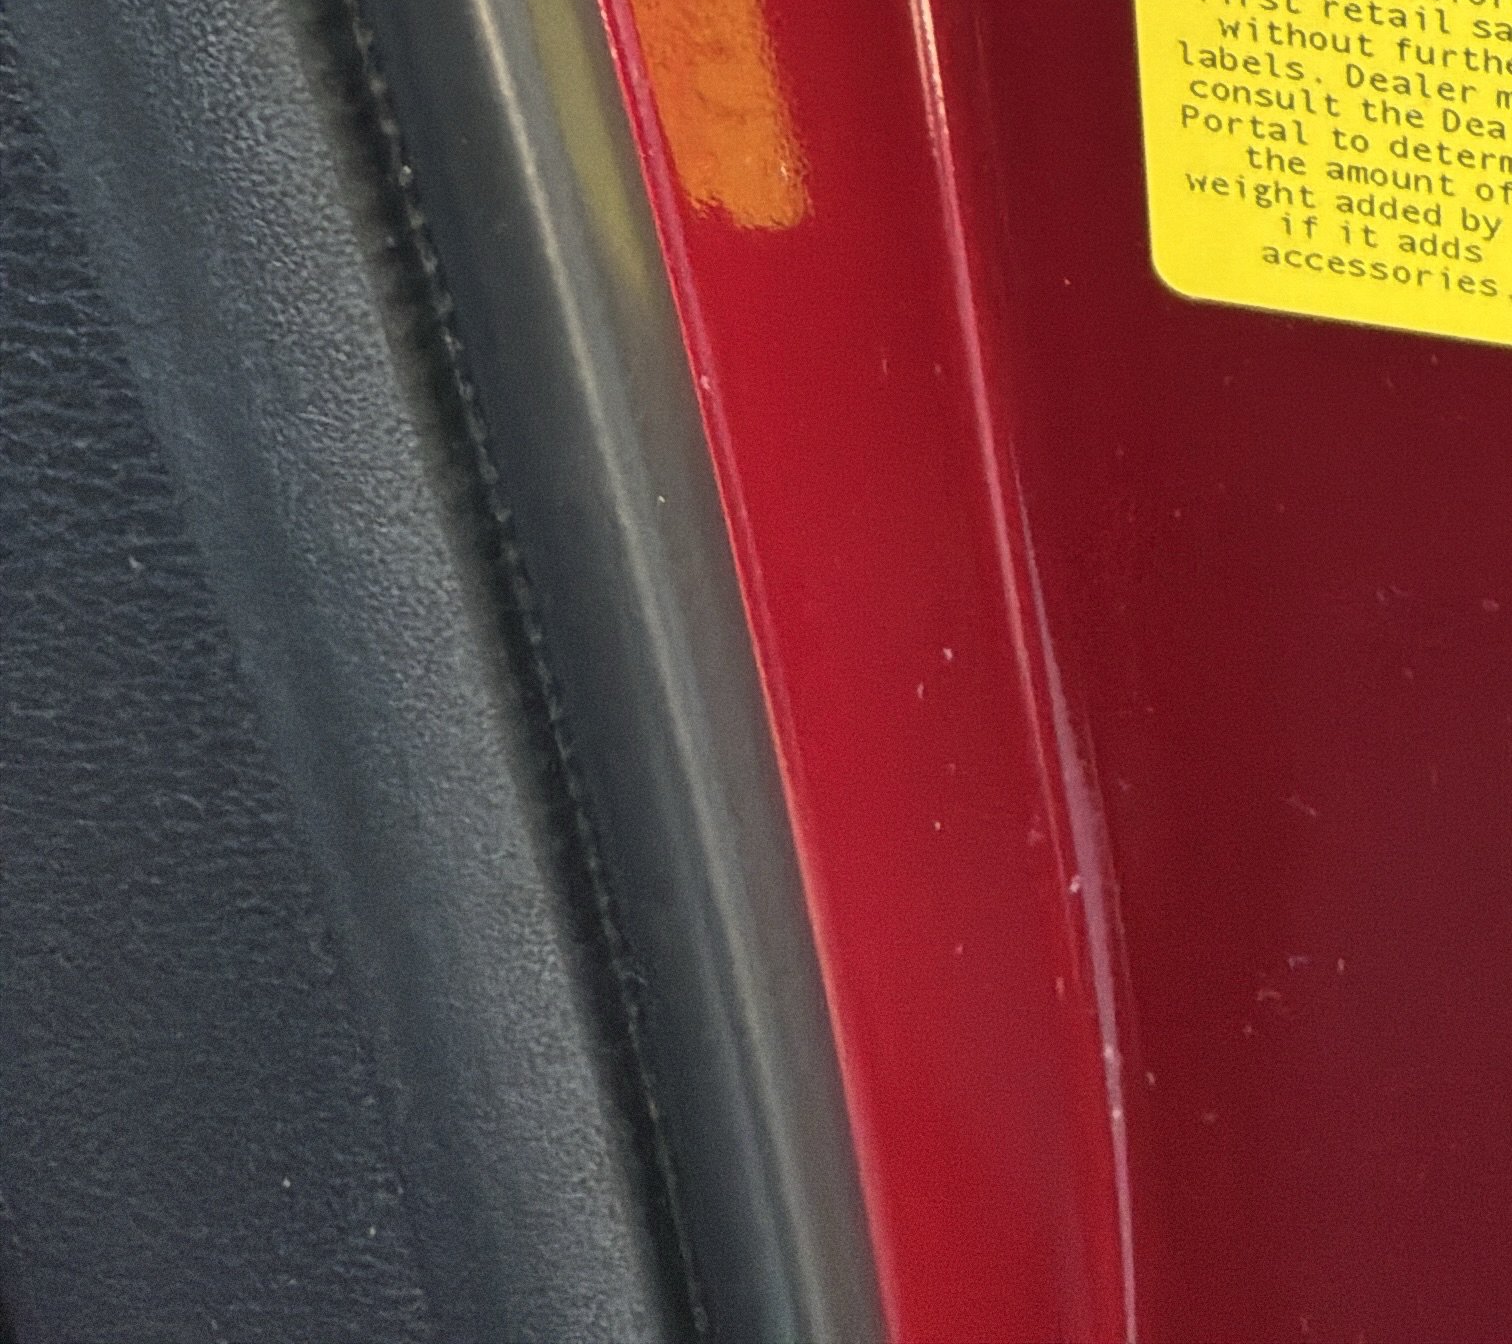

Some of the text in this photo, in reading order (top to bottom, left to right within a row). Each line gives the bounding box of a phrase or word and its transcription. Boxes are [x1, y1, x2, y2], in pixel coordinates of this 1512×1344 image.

[1216, 16, 1374, 59] without
[1177, 39, 1322, 84] labels.
[1344, 62, 1477, 104] Dealer
[1180, 102, 1308, 146] Portal
[1331, 126, 1370, 154] to
[1188, 78, 1341, 118] consult
[1360, 97, 1425, 130] the
